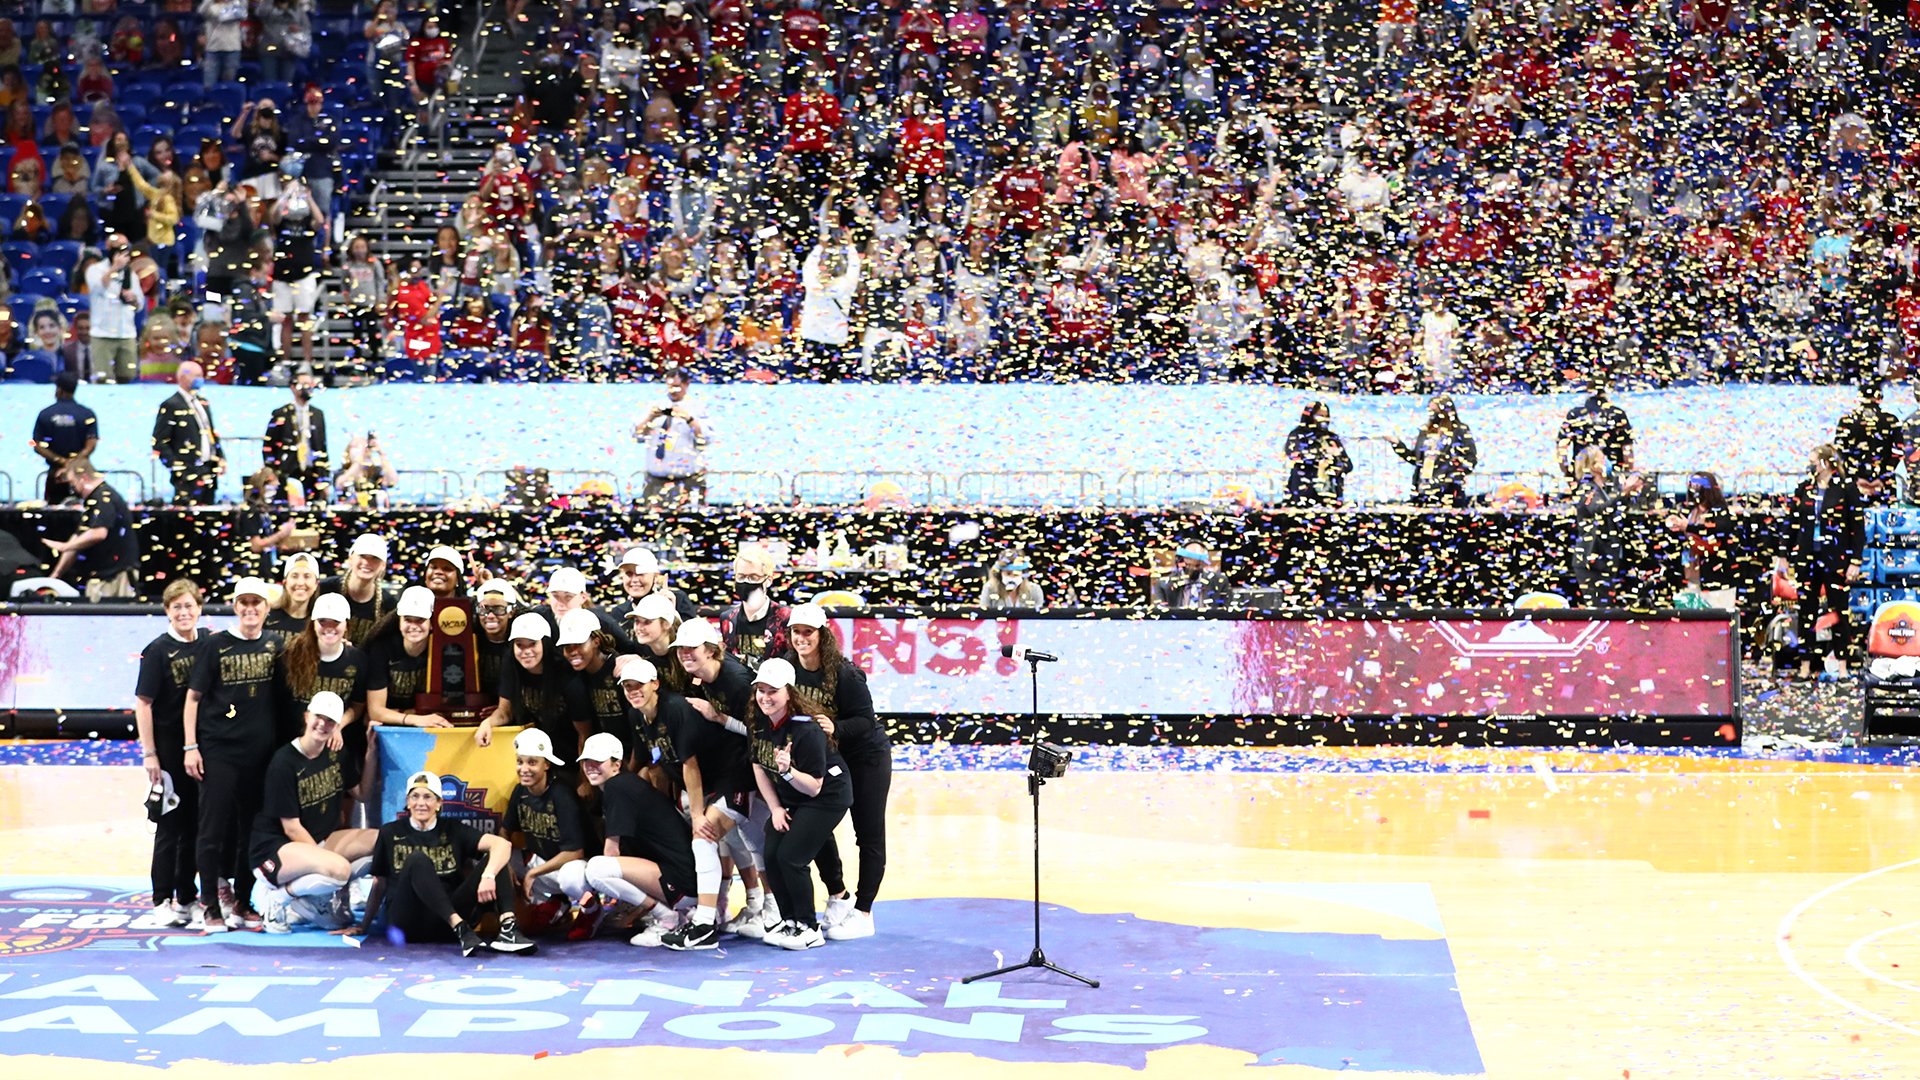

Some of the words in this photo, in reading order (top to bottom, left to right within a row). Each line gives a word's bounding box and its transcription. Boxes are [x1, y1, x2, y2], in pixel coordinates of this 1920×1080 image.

[441, 620, 466, 629] NCAA
[826, 619, 1020, 677] NS!
[0, 927, 128, 935] TONIO
[0, 973, 1068, 1010] ATIONAL
